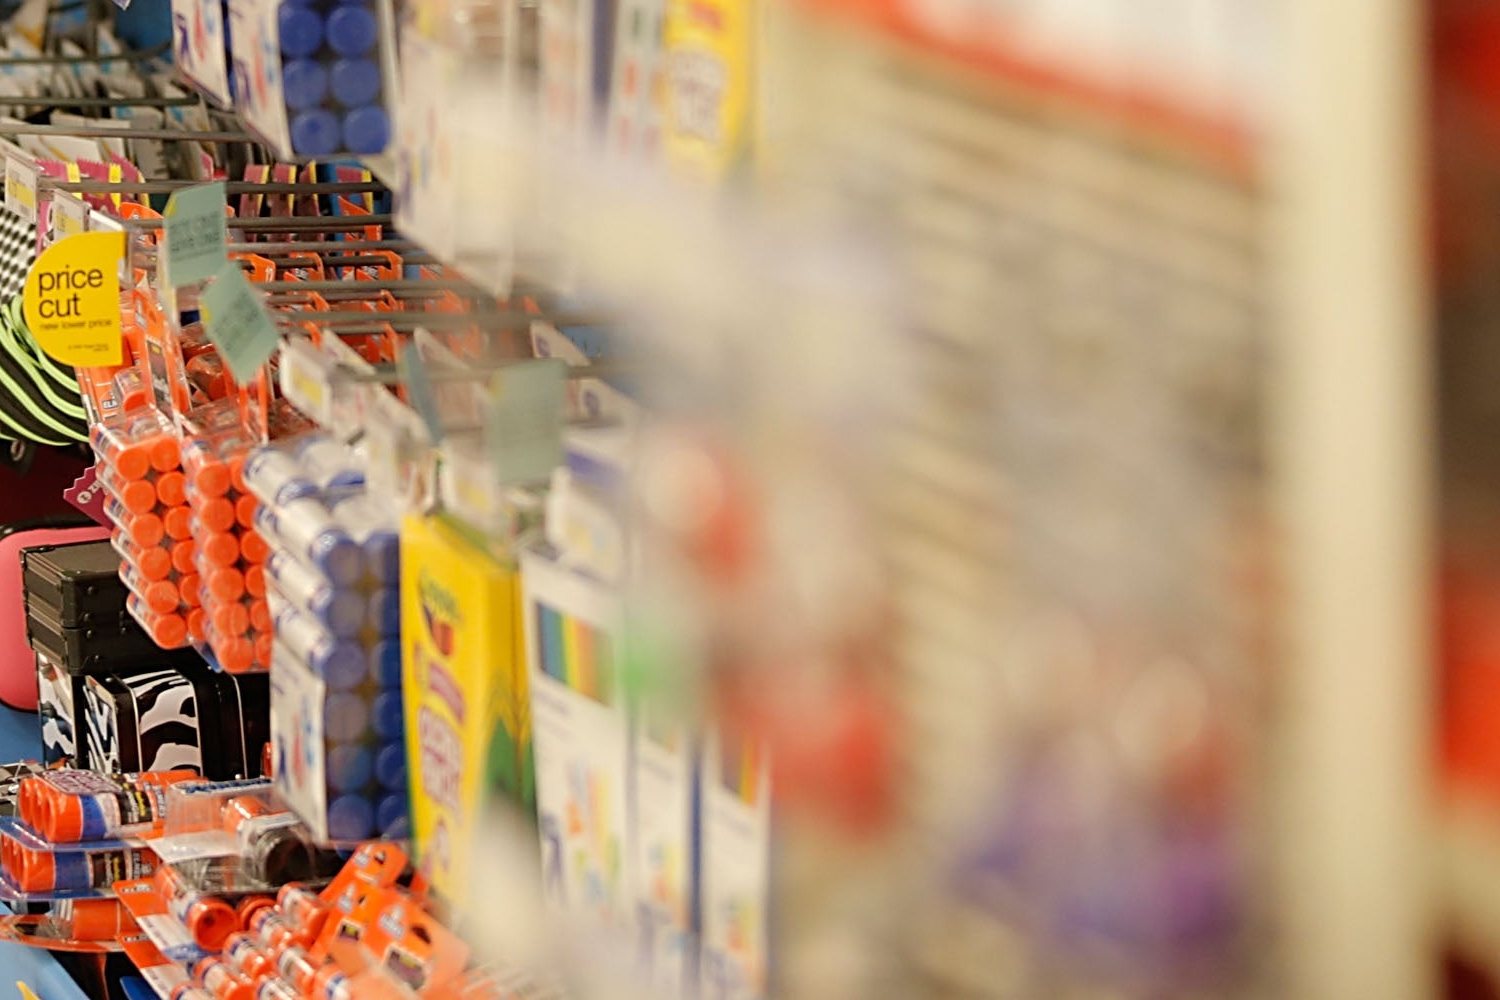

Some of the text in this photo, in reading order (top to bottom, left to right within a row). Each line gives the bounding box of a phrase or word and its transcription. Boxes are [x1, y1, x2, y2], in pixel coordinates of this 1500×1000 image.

[38, 265, 103, 297] price
[38, 293, 81, 318] cut
[40, 319, 112, 331] new lower price
